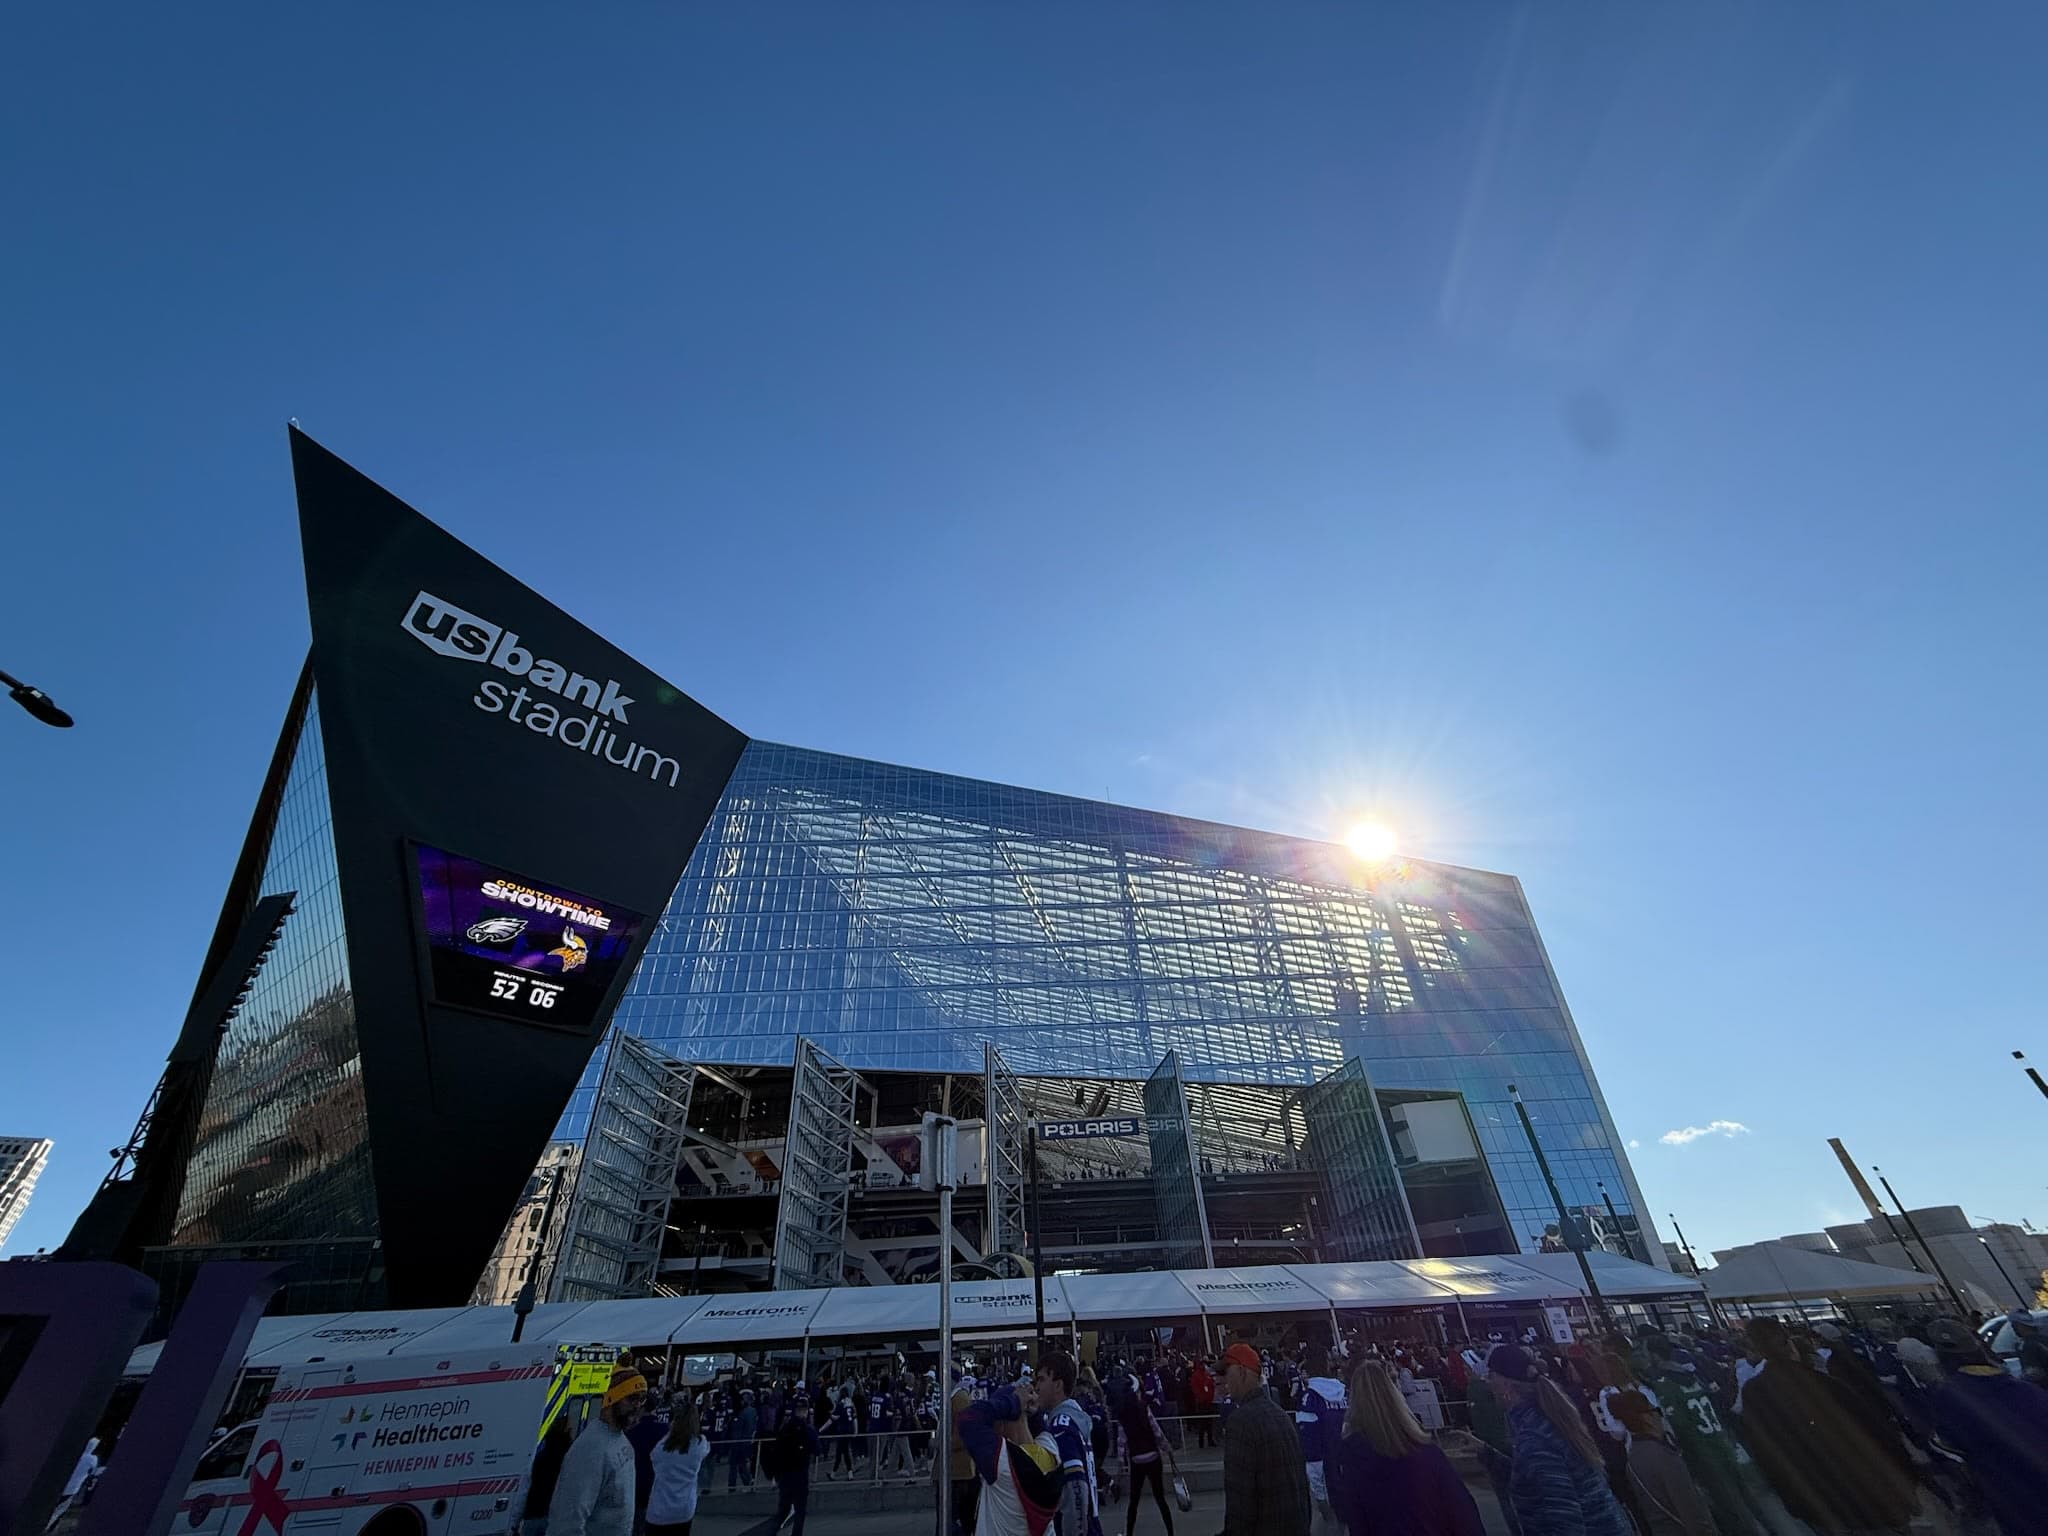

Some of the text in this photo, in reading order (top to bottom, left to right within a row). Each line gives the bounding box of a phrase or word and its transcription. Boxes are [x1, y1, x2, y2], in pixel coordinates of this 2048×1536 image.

[474, 680, 681, 788] stadium
[481, 881, 612, 931] SHOWTIME
[496, 879, 603, 917] COUNTDOWN TO
[489, 978, 558, 1009] 52 06
[1043, 1120, 1134, 1137] POLARIS
[1197, 1280, 1297, 1290] Medtronic
[704, 1305, 809, 1317] Medtronic
[380, 1396, 470, 1422] Hennepin
[871, 1403, 881, 1419] 18
[1052, 1413, 1071, 1427] 18
[372, 1422, 483, 1448] Healthcare
[363, 1455, 439, 1476] HENNEPIN
[443, 1452, 475, 1468] EMS
